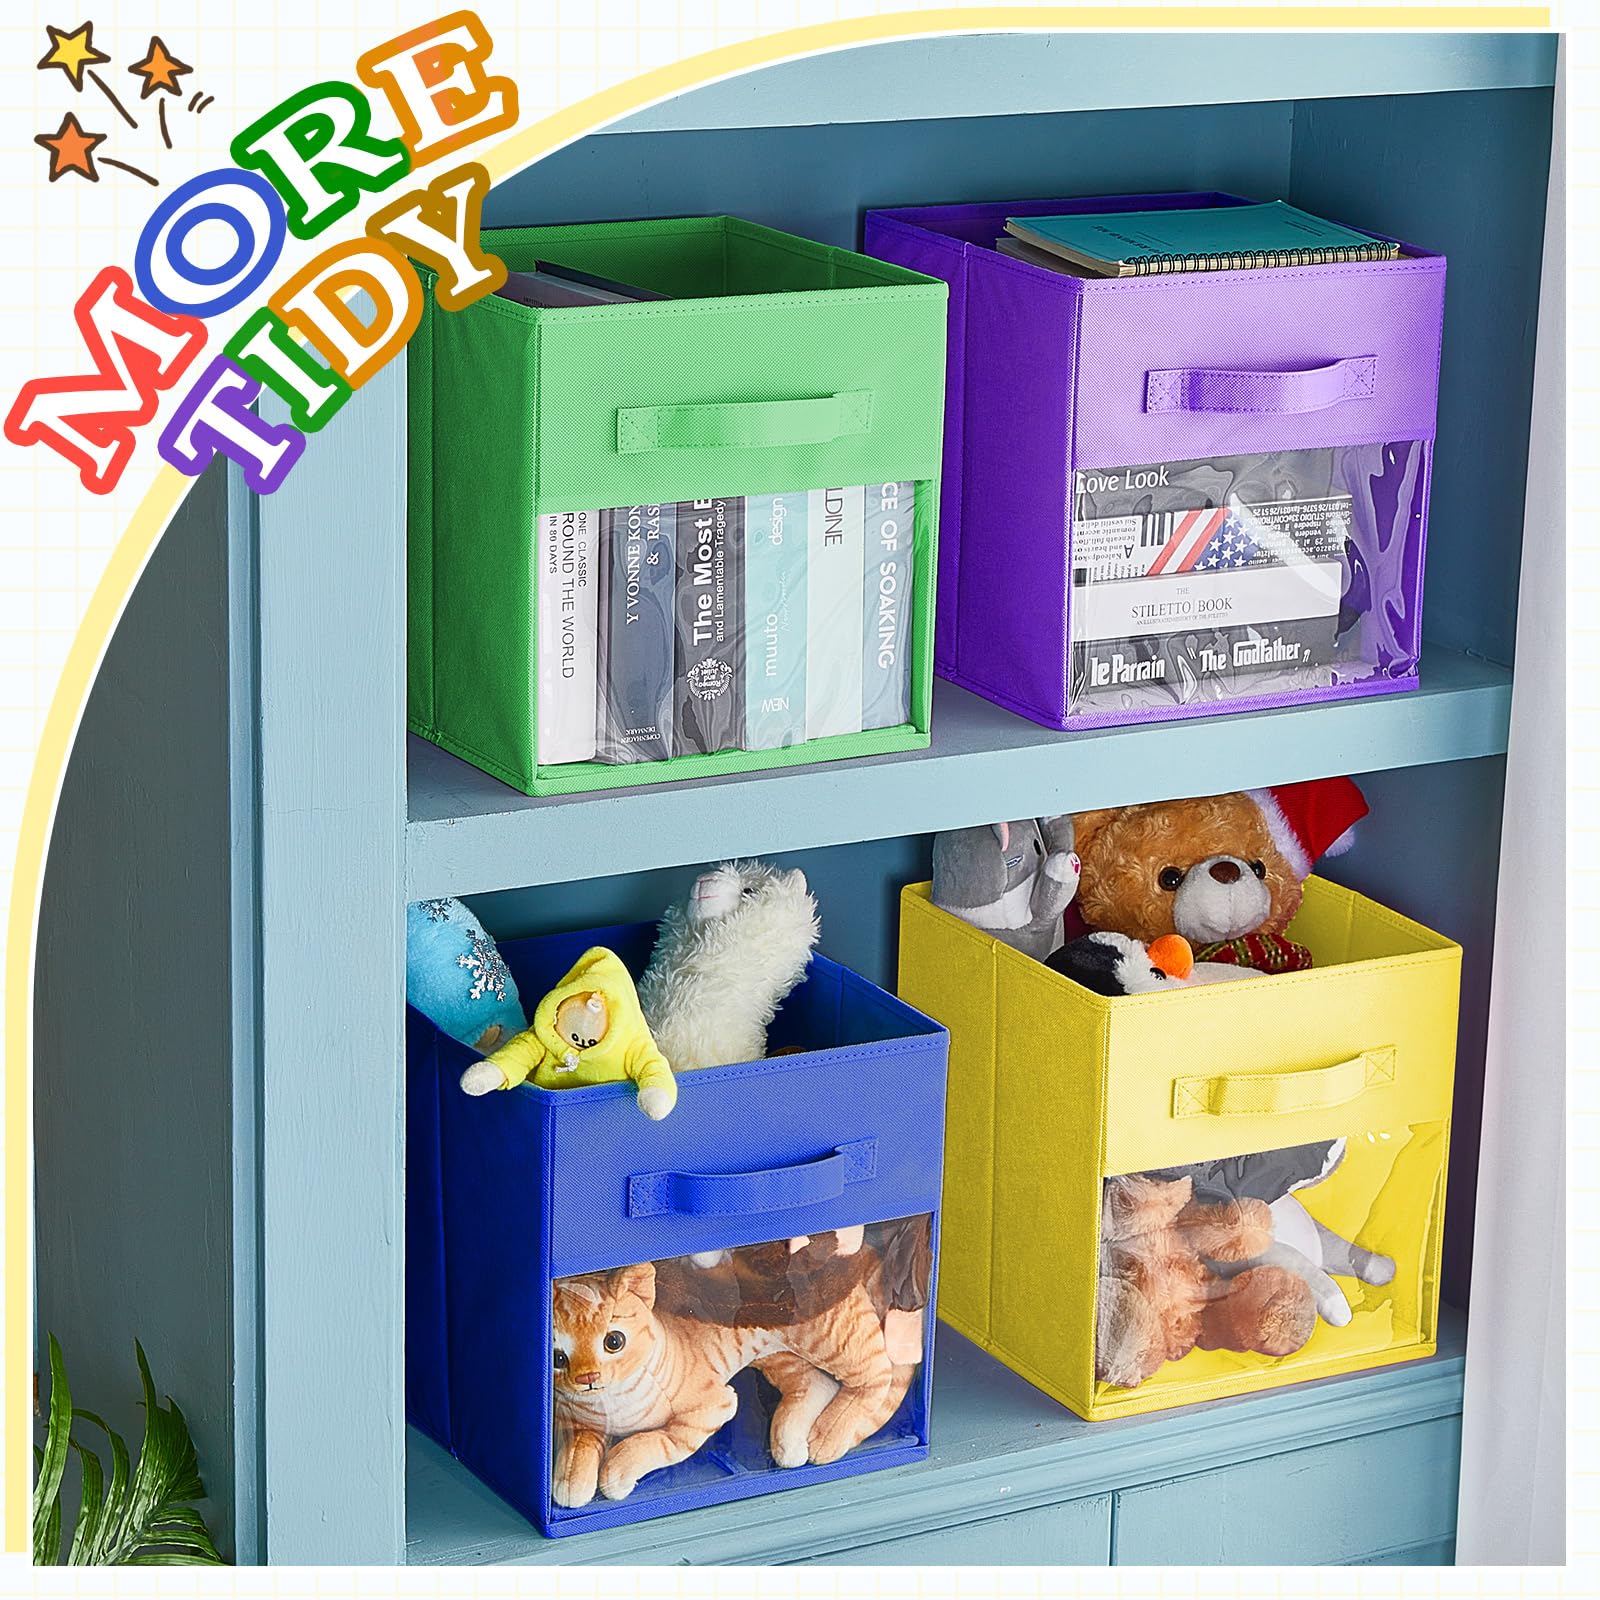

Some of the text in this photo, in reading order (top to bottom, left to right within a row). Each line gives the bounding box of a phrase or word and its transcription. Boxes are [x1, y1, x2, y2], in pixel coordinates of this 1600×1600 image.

[1125, 465, 1170, 490] Look
[768, 497, 787, 545] design
[825, 487, 843, 546] LDINE
[1300, 512, 1324, 521] STUDIO
[549, 515, 557, 574] IN 80 DAYS
[577, 512, 587, 587] ONE CLASSIC
[647, 552, 659, 566] &
[693, 517, 712, 586] Most
[1123, 544, 1135, 559] A
[715, 500, 726, 642] and Lamentable Tragedy
[878, 482, 898, 669] CE OF SOAKING
[1176, 587, 1190, 595] THE
[561, 512, 575, 679] ROUND THE WORLD
[1131, 597, 1233, 618] STILETTO BOOK
[693, 594, 712, 646] The
[764, 614, 778, 677] muuto
[1111, 654, 1165, 684] Parrain
[1199, 649, 1227, 673] The
[1233, 637, 1301, 667] Godfather
[700, 668, 719, 676] Juliet
[761, 696, 790, 713] NEW
[620, 733, 661, 744] COPENHAGEN
[625, 726, 656, 736] DENMARK
